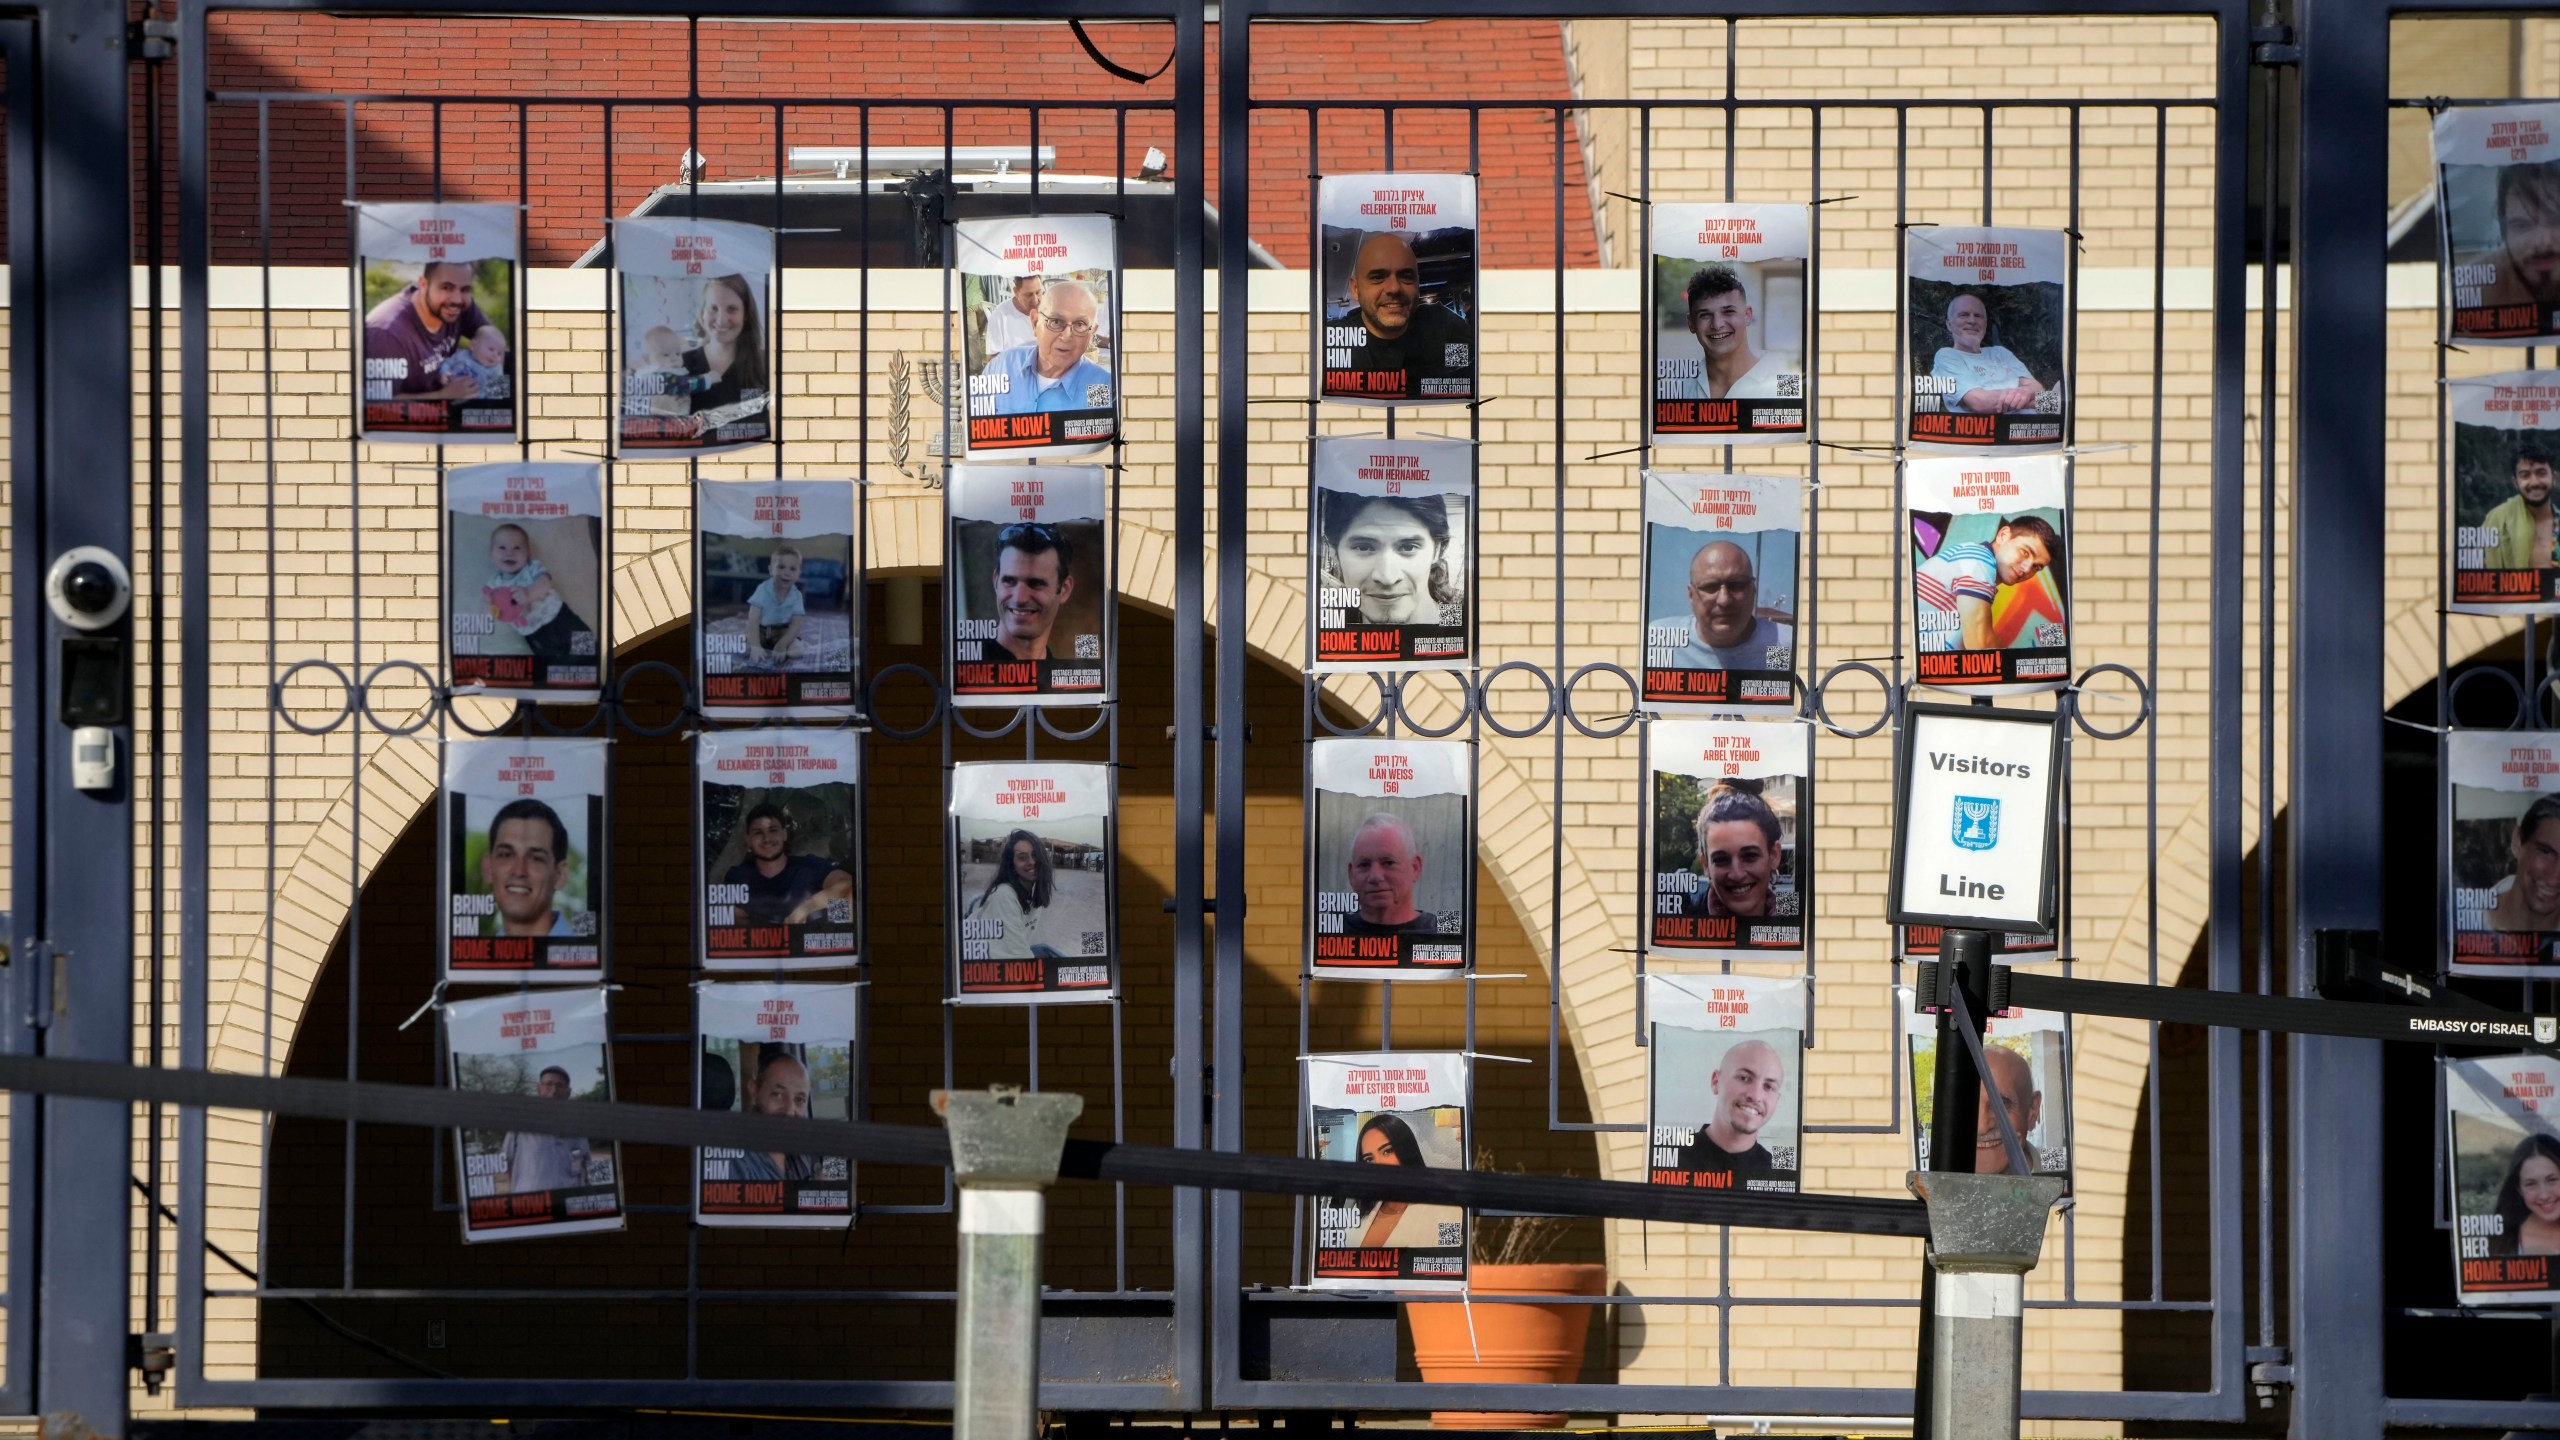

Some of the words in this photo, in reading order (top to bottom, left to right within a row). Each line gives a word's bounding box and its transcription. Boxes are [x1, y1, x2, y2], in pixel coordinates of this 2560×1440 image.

[2486, 136, 2517, 148] ANDREY
[2518, 133, 2550, 146] KOZLOV
[2510, 149, 2527, 160] (27)
[1374, 190, 1400, 202] גלרנטר
[1401, 190, 1425, 203] איציק
[1361, 203, 1408, 215] GELERENTER
[1408, 203, 1437, 215] ITZHAK
[1390, 216, 1407, 228] (56)
[1705, 219, 1726, 232] ליבמן
[1727, 219, 1756, 231] אליקים
[410, 232, 438, 245] YARDEN
[440, 232, 465, 245] BIBAS
[1014, 234, 1031, 246] קופר
[1033, 234, 1057, 245] עמירם
[1698, 232, 1731, 244] ELYAKIM
[1732, 233, 1763, 244] LIBMAN
[1004, 248, 1036, 259] AMIRAM
[1037, 246, 1068, 258] COOPER
[1721, 246, 1739, 257] (24)
[1027, 260, 1044, 272] (84)
[1943, 255, 1967, 267] KEITH
[1966, 255, 1998, 269] SAMUEL
[2000, 256, 2025, 268] SIEGEL
[1978, 269, 1996, 280] (64)
[1326, 326, 1367, 348] BRING
[1327, 349, 1352, 368] HIM
[1657, 359, 1698, 378] BRING
[970, 374, 1010, 395] BRING
[1326, 371, 1364, 391] HOME
[1367, 369, 1406, 391] NOW!
[1420, 386, 1450, 394] FAMILIES
[1452, 386, 1470, 394] FORUM
[1658, 380, 1684, 400] HIM
[970, 395, 996, 416] HIM
[1657, 403, 1696, 422] HOME
[1698, 400, 1738, 422] NOW!
[2484, 400, 2510, 412] HERSH
[971, 418, 1008, 439] HOME
[1012, 413, 1050, 436] NOW!
[1358, 468, 1386, 480] ORYON
[1384, 468, 1430, 481] HERNANDEZ
[1961, 472, 1983, 484] הרקין
[1984, 471, 2011, 483] מקסים
[1387, 482, 1401, 493] (21)
[1953, 486, 1988, 497] MAKSYM
[1989, 485, 2020, 496] HARKIN
[1010, 494, 1032, 506] DROR
[1034, 494, 1044, 505] OR
[1700, 489, 1721, 501] זוקוב
[1724, 490, 1750, 502] ולדימיר
[1693, 502, 1730, 514] VLADIMIR
[1732, 504, 1756, 515] ZUKOV
[1978, 498, 1995, 509] (35)
[754, 508, 774, 521] ARIEL
[777, 508, 800, 522] BIBAS
[1020, 509, 1036, 520] (48)
[772, 521, 784, 534] (4)
[1715, 516, 1733, 528] (64)
[2458, 527, 2500, 547] BRING
[2458, 548, 2484, 569] HIM
[2457, 573, 2496, 593] HOME
[2499, 570, 2540, 592] NOW!
[1320, 588, 1361, 608] BRING
[1320, 609, 1346, 629] HIM
[1919, 610, 1960, 632] BRING
[957, 620, 998, 640] BRING
[1320, 631, 1359, 651] HOME
[1362, 630, 1400, 651] NOW!
[1920, 632, 1946, 652] HIM
[957, 641, 982, 661] HIM
[1920, 654, 1959, 675] HOME
[1962, 651, 2002, 674] NOW!
[957, 664, 996, 684] HOME
[999, 662, 1038, 684] NOW!
[1713, 736, 1730, 748] יהוד
[1732, 736, 1751, 748] ארבל
[1375, 755, 1390, 766] וייס
[1391, 755, 1408, 768] אילן
[1703, 749, 1727, 761] ARBEL
[1729, 750, 1760, 762] YEHOUD
[717, 758, 762, 770] ALEXANDER
[762, 758, 795, 771] (SASHA)
[797, 758, 838, 770] TRUPANOB
[1723, 762, 1740, 775] (28)
[1929, 752, 2030, 779] Visitors
[2501, 762, 2528, 774] HADAR
[2528, 762, 2560, 774] GOLDIN
[770, 772, 786, 784] (28)
[1369, 768, 1387, 780] ILAN
[1388, 768, 1414, 780] WEISS
[1007, 779, 1039, 791] ירושלמי
[1041, 779, 1054, 791] עדן
[1383, 781, 1400, 793] (56)
[2522, 775, 2538, 788] (32)
[996, 793, 1016, 805] EDEN
[1016, 792, 1066, 804] YERUSHALMI
[1022, 805, 1040, 817] (24)
[1657, 872, 1698, 894] BRING
[1940, 874, 2004, 900] Line
[1318, 892, 1359, 913] BRING
[1657, 894, 1683, 914] HER
[963, 919, 1004, 940] BRING
[1318, 914, 1344, 934] HIM
[1656, 918, 1695, 938] HOME
[1697, 916, 1736, 939] NOW!
[963, 941, 990, 960] HER
[1317, 937, 1357, 957] HOME
[1360, 935, 1398, 957] NOW!
[1412, 952, 1442, 961] FAMILIES
[1443, 952, 1461, 961] FORUM
[963, 962, 1002, 982] HOME
[1005, 960, 1044, 982] NOW!
[1713, 989, 1725, 1001] מור
[1727, 990, 1744, 1001] איתן
[1707, 1002, 1730, 1013] EITAN
[1731, 1002, 1749, 1014] MOR
[756, 1014, 777, 1026] EITAN
[778, 1014, 800, 1026] LEVY
[1719, 1015, 1737, 1027] (23)
[770, 1026, 786, 1038] (53)
[2410, 1018, 2467, 1033] EMBASSY
[2470, 1022, 2486, 1033] OF
[2489, 1022, 2531, 1036] ISRAEL
[1348, 1070, 1381, 1082] בוסקילה
[1384, 1070, 1404, 1081] אסתר
[1407, 1069, 1426, 1080] עמית
[1345, 1082, 1365, 1094] AMIT
[1367, 1082, 1396, 1094] ESTHER
[1397, 1082, 1430, 1094] BUSKILA
[2503, 1086, 2532, 1098] NAAMA
[2534, 1086, 2554, 1096] LEVY
[1379, 1095, 1397, 1108] (28)
[2522, 1100, 2538, 1112] (19)
[1320, 1208, 1362, 1229] BRING
[2460, 1215, 2503, 1236] BRING
[1320, 1229, 1347, 1248] HER
[2462, 1237, 2489, 1258] HER
[1319, 1250, 1357, 1268] HOME
[1360, 1248, 1399, 1268] NOW!
[2463, 1262, 2502, 1283] HOME
[2506, 1256, 2547, 1281] NOW!
